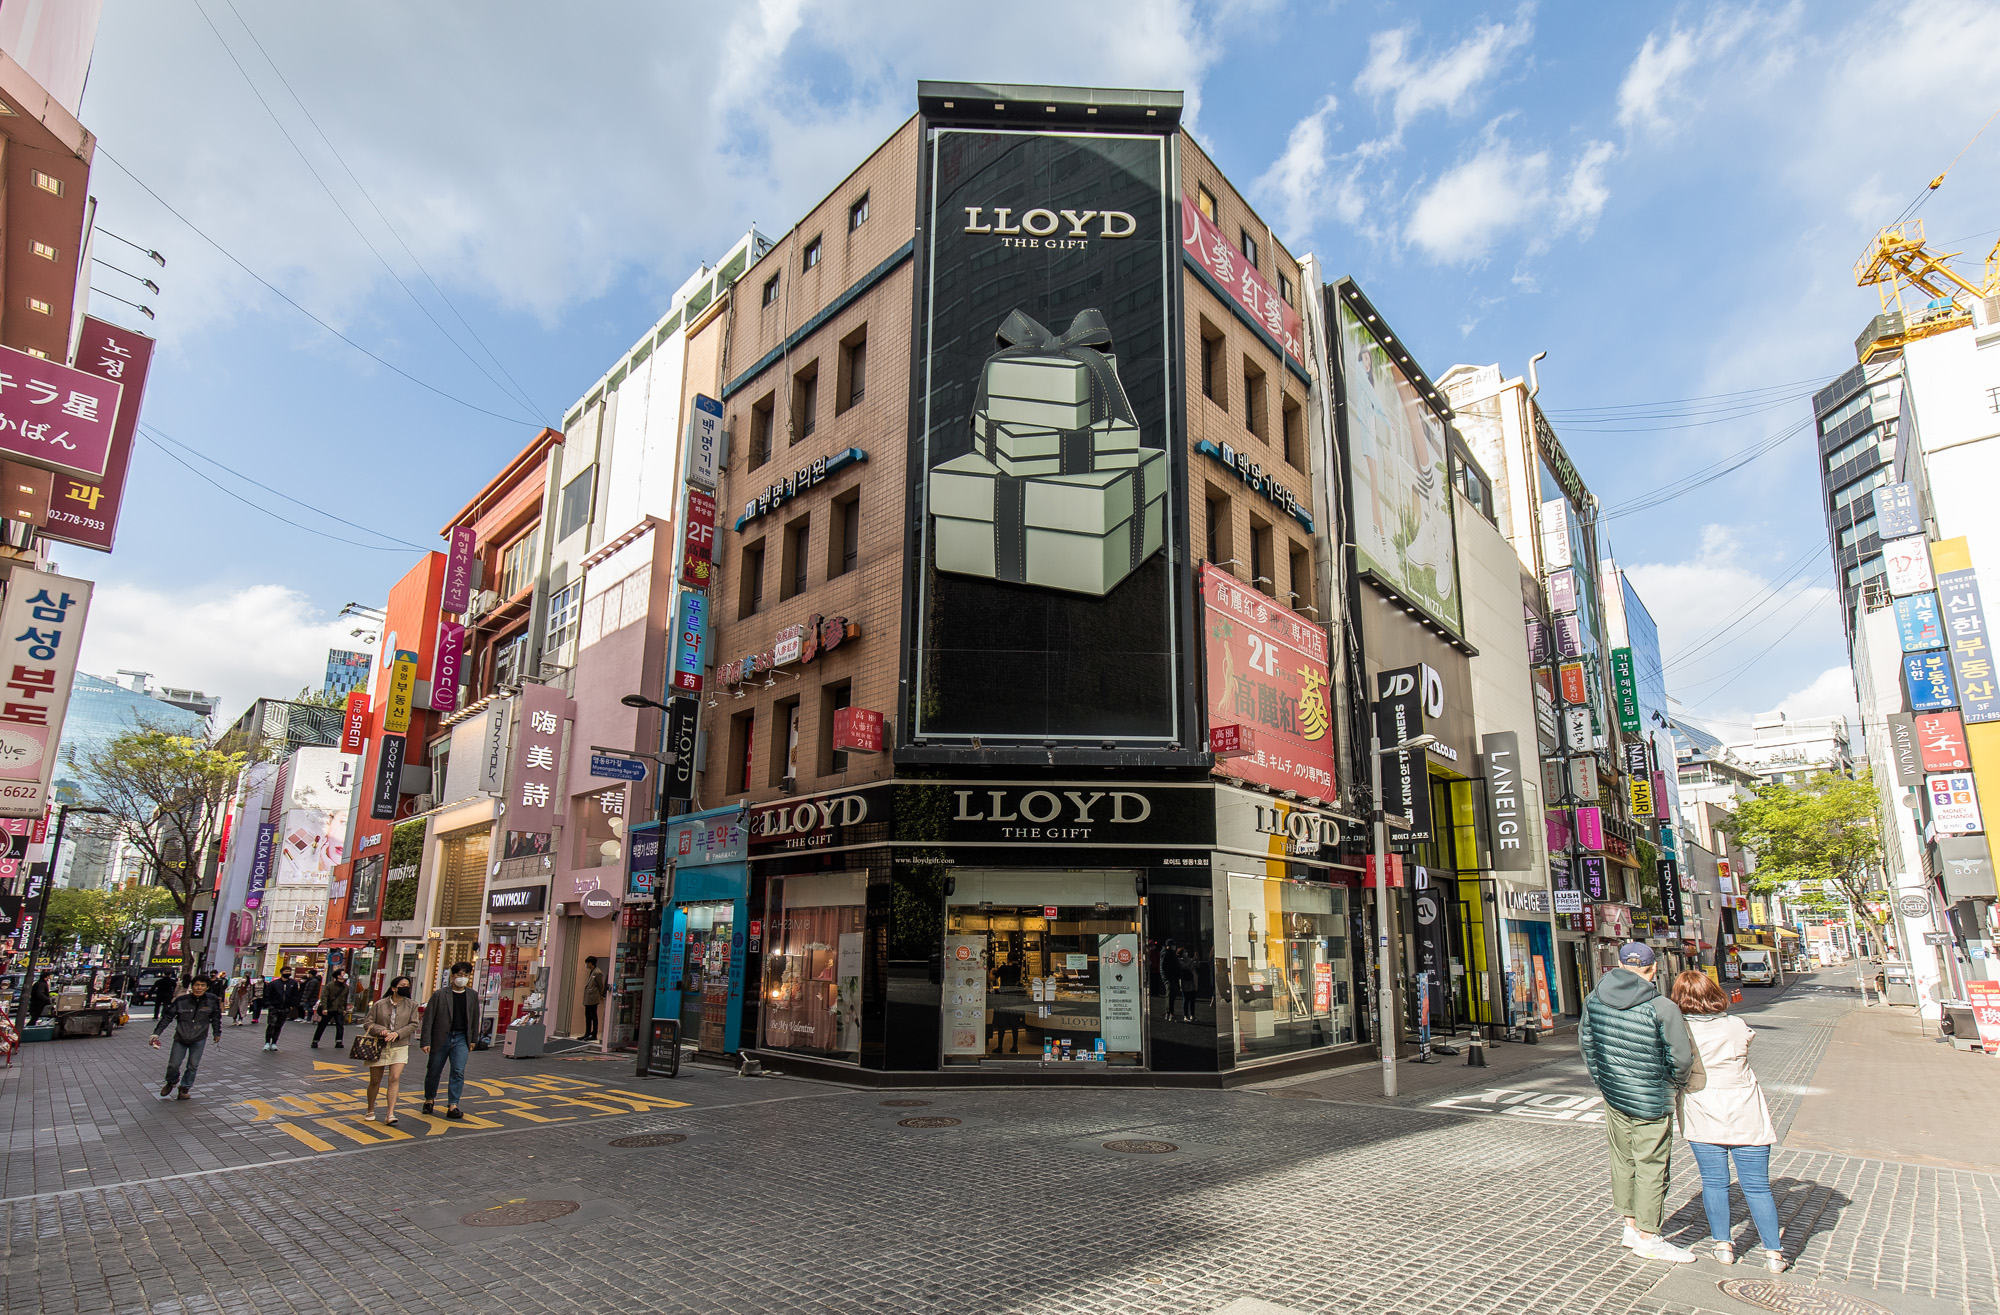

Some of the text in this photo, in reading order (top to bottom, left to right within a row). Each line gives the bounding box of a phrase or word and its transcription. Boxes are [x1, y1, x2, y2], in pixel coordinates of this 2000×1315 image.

[964, 207, 1137, 237] LLOYD
[1002, 238, 1088, 249] THE GIFT
[98, 337, 132, 378] 노정
[1285, 330, 1301, 358] 2F
[701, 418, 715, 468] 백명기
[698, 466, 711, 477] 의원
[759, 455, 826, 514] 백명기의원
[1237, 452, 1296, 517] 백명기의원
[65, 480, 105, 510] 과
[48, 510, 105, 531] 02.778-7933
[688, 521, 713, 543] 2F
[456, 531, 470, 564] 제일사
[451, 566, 467, 600] 옷수선
[1424, 594, 1445, 620] NIZZA
[683, 599, 702, 669] 푸른약국
[1562, 625, 1574, 655] HOTEL
[1905, 640, 1929, 651] Cafe
[1247, 633, 1279, 677] 2F
[1617, 653, 1629, 677] 가꿈
[682, 674, 696, 688] 药
[1908, 659, 1924, 681] 신한
[1382, 673, 1415, 699] JD
[1568, 677, 1579, 700] 부동산
[1620, 678, 1634, 716] 헤어드림
[353, 699, 364, 713] the
[1977, 703, 1990, 711] 3F
[348, 714, 363, 748] SAEM
[387, 739, 399, 769] MOON
[489, 708, 504, 784] TONYMOLY
[522, 710, 558, 808] 嗨美詩
[677, 714, 694, 782] LLOYD
[1631, 744, 1645, 774] NAIL
[1895, 723, 1916, 775] ARITAUM
[592, 756, 622, 768] 명동8가길
[383, 771, 394, 800] HAIR
[1401, 776, 1412, 805] KING
[1578, 760, 1590, 798] 새마을식당
[1934, 781, 1946, 791] 元
[953, 790, 1151, 823] LLOYD
[1491, 751, 1520, 850] LANEIGE
[1633, 783, 1649, 812] HAIR
[761, 795, 868, 837] LLOYD
[1255, 805, 1340, 846] LLOYD
[258, 828, 271, 860] HOLIKA
[696, 825, 740, 851] 푸른약국
[785, 834, 833, 848] THE GIFT
[1002, 827, 1091, 839] THE GIFT
[251, 861, 266, 893] HOLIKA
[387, 858, 418, 884] innisfree
[1163, 858, 1209, 867] 로이드 명동1호점
[27, 875, 43, 899] FILA
[1589, 868, 1601, 898] 노래방
[1663, 862, 1677, 922] TONYMOLY
[294, 905, 324, 917] HOL
[492, 891, 527, 908] TONYMOLY
[587, 899, 611, 907] heimish
[1507, 890, 1541, 912] LANEIGE
[19, 919, 33, 949] swatch
[293, 919, 322, 932] HOL
[489, 949, 503, 957] SA
[693, 942, 705, 967] 약
[770, 1019, 816, 1034] Be My Valentine
[1061, 1016, 1099, 1027] LLOYD
